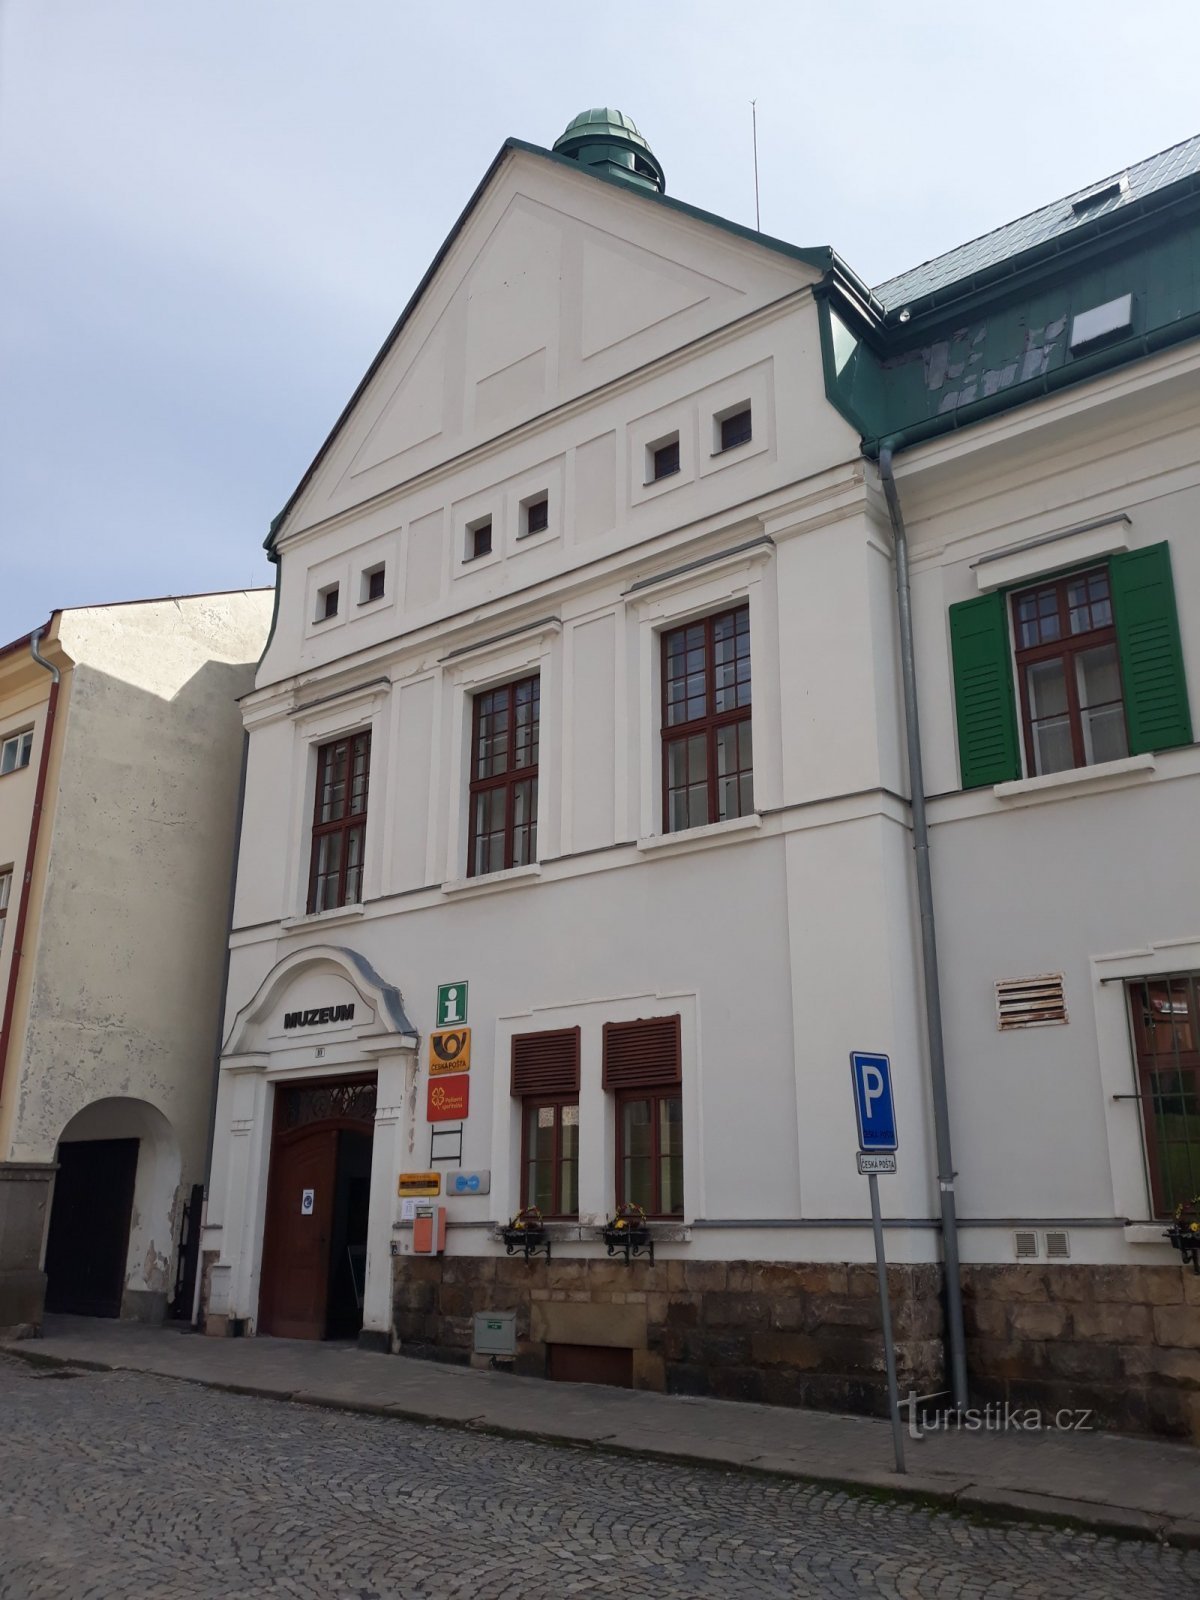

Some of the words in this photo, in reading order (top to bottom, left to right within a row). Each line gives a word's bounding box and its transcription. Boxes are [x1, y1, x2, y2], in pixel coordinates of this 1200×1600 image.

[284, 1003, 355, 1029] MUZEUM
[862, 1065, 884, 1118] P
[861, 1158, 878, 1169] ČESKÁ
[879, 1158, 895, 1169] POŠTA
